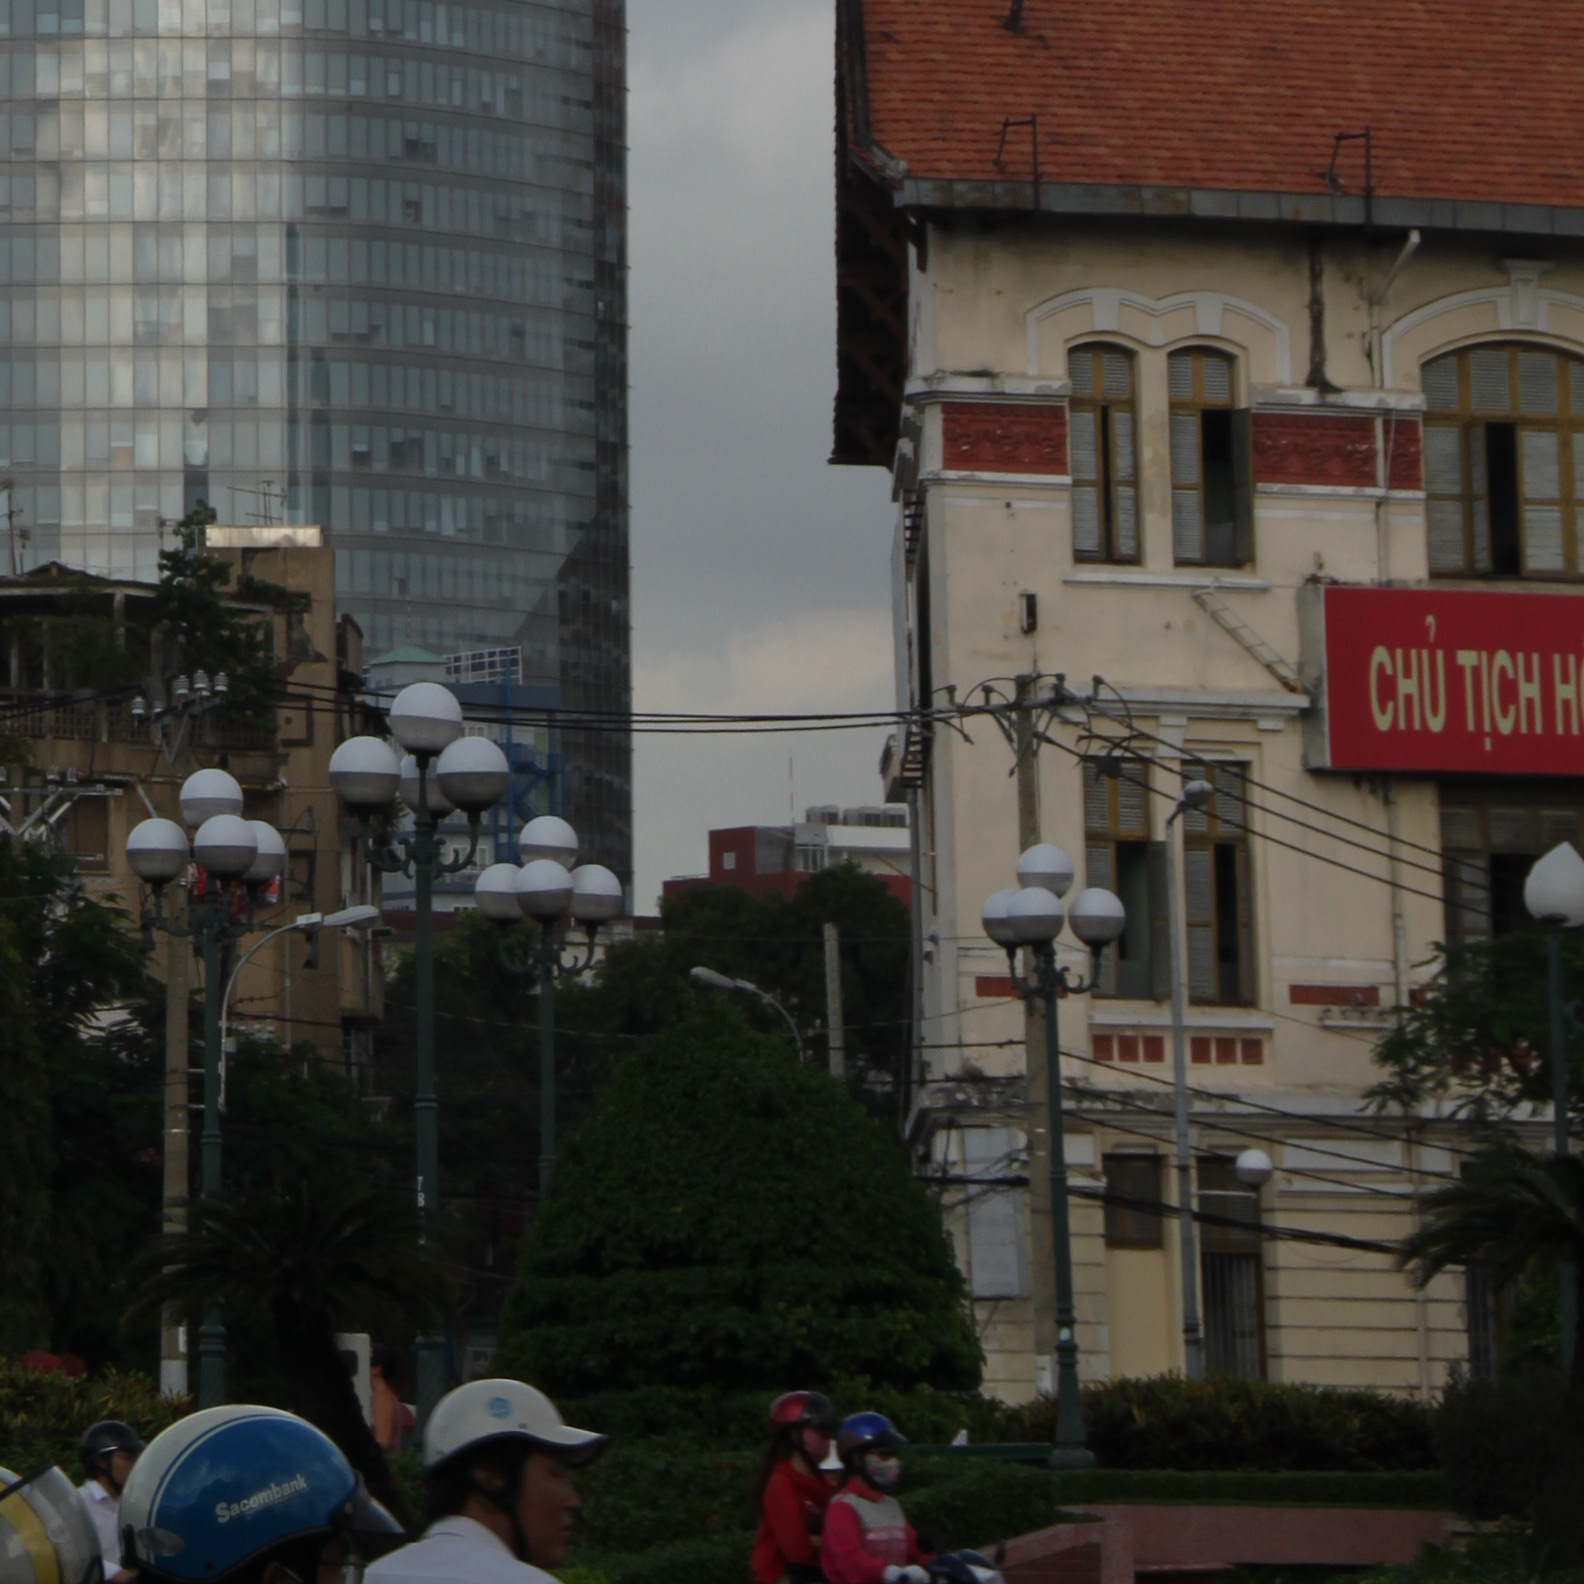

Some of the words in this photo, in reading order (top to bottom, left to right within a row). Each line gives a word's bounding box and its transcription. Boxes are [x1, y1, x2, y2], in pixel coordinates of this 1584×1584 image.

[1369, 614, 1446, 733] CHỦ
[1456, 649, 1543, 752] TỊCH
[1553, 642, 1584, 736] H
[215, 1473, 309, 1524] Sacombank
